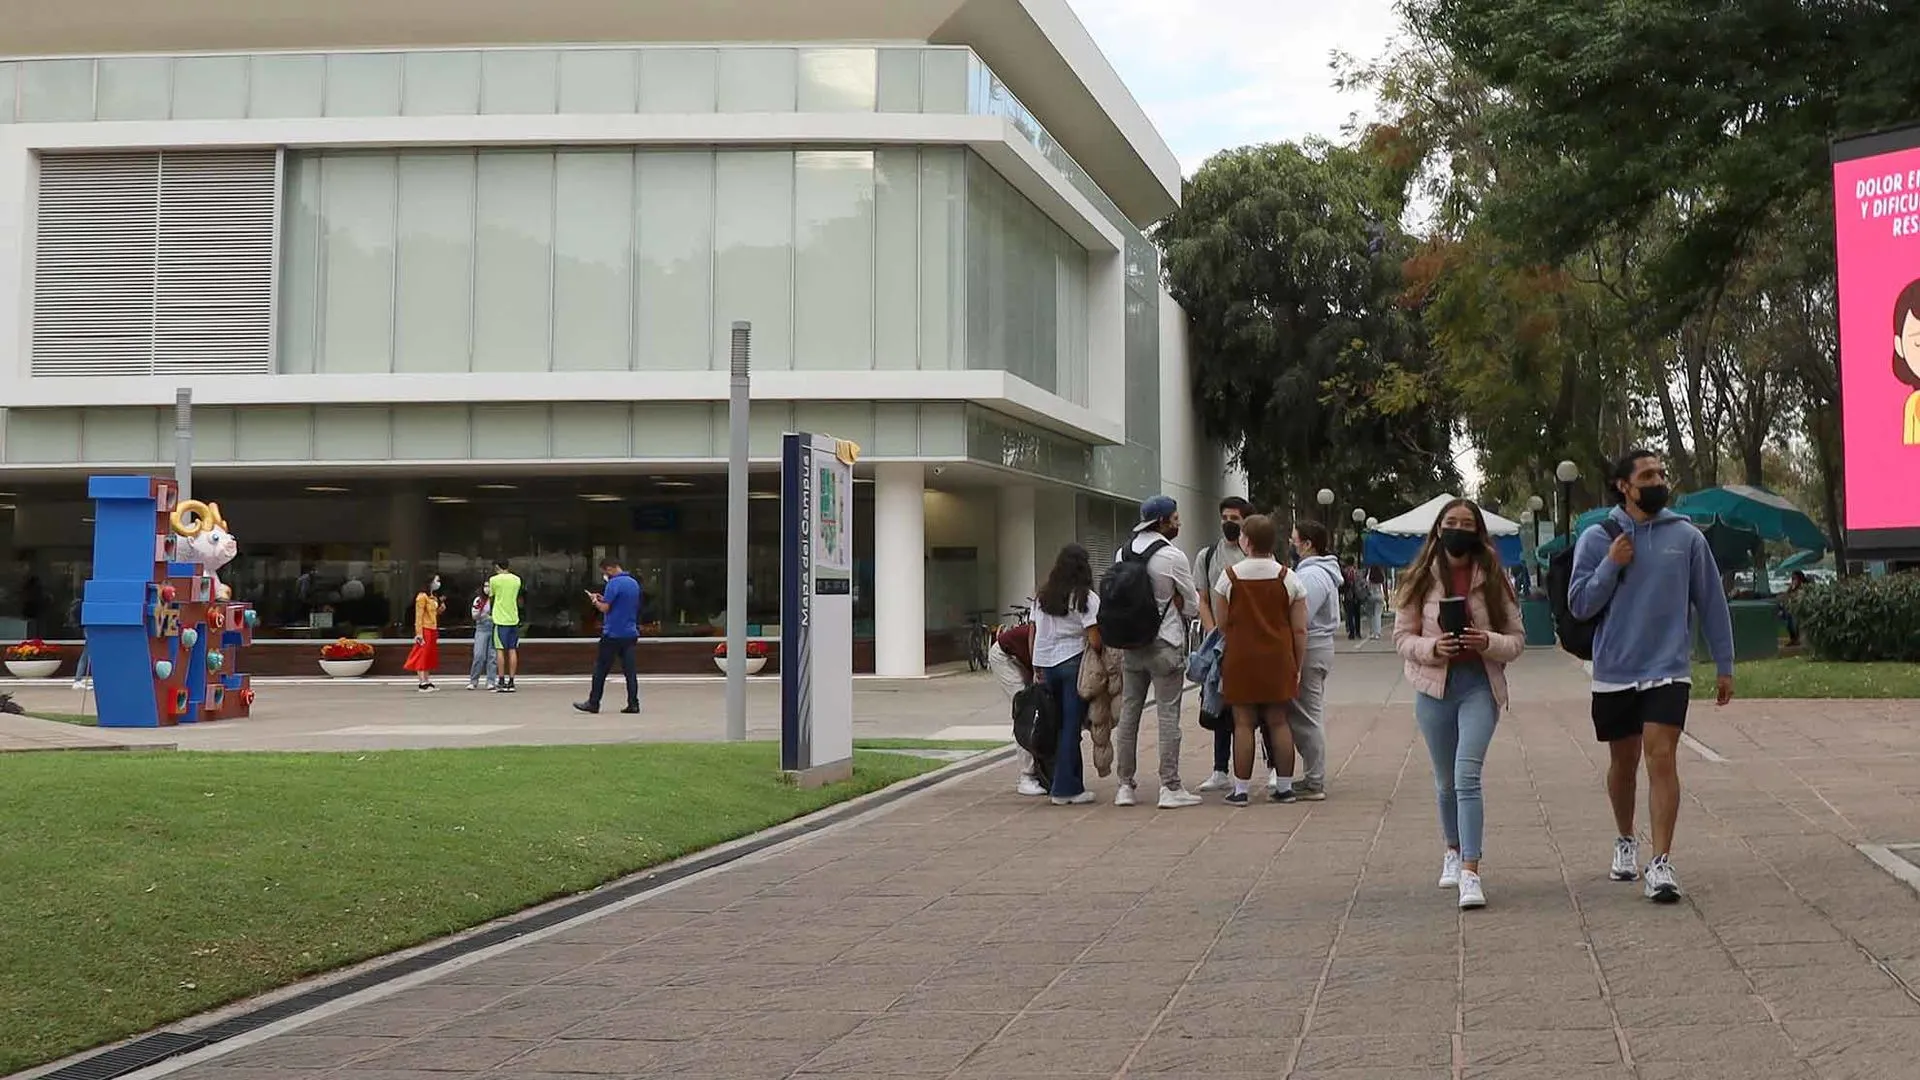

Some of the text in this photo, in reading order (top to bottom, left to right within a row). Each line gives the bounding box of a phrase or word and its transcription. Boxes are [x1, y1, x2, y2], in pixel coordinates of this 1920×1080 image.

[1856, 172, 1903, 199] DOLOR
[1861, 192, 1920, 220] Y DIFICU
[1893, 214, 1920, 237] RES
[801, 455, 810, 626] Mapa del Campus
